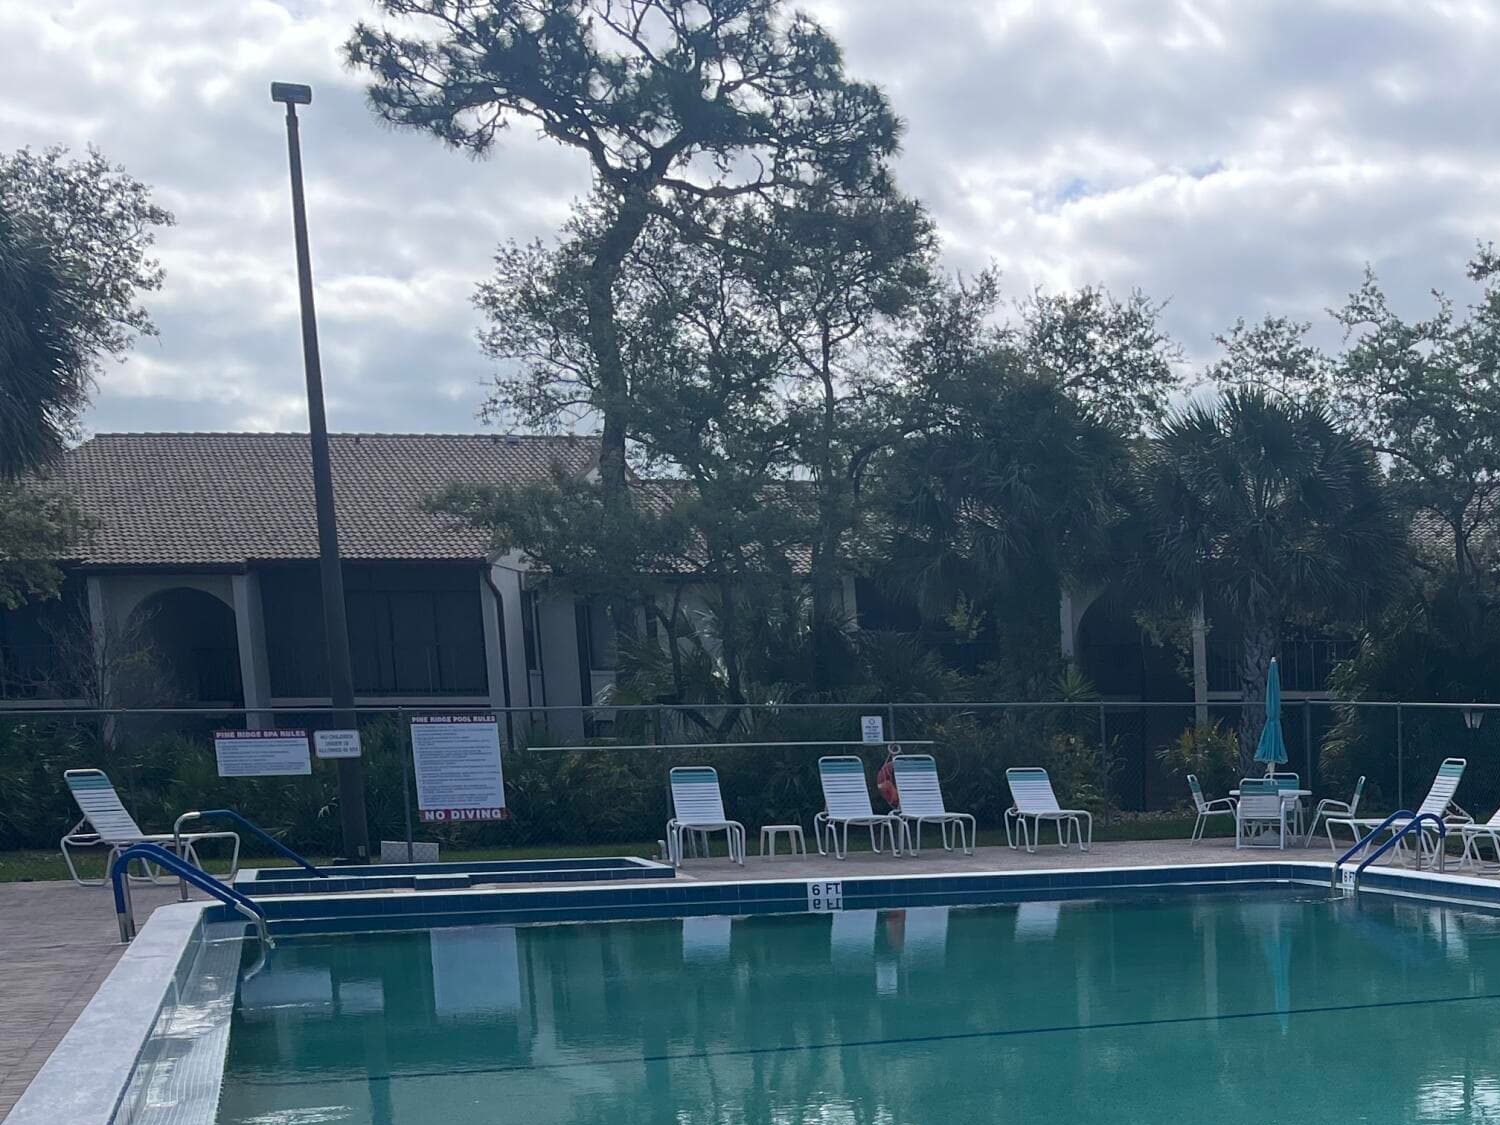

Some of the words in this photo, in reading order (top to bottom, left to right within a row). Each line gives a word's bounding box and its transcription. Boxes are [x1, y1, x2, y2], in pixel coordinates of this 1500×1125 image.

[263, 730, 278, 738] SPA
[425, 810, 446, 820] NO
[450, 809, 502, 820] DIVING
[812, 884, 821, 896] 6
